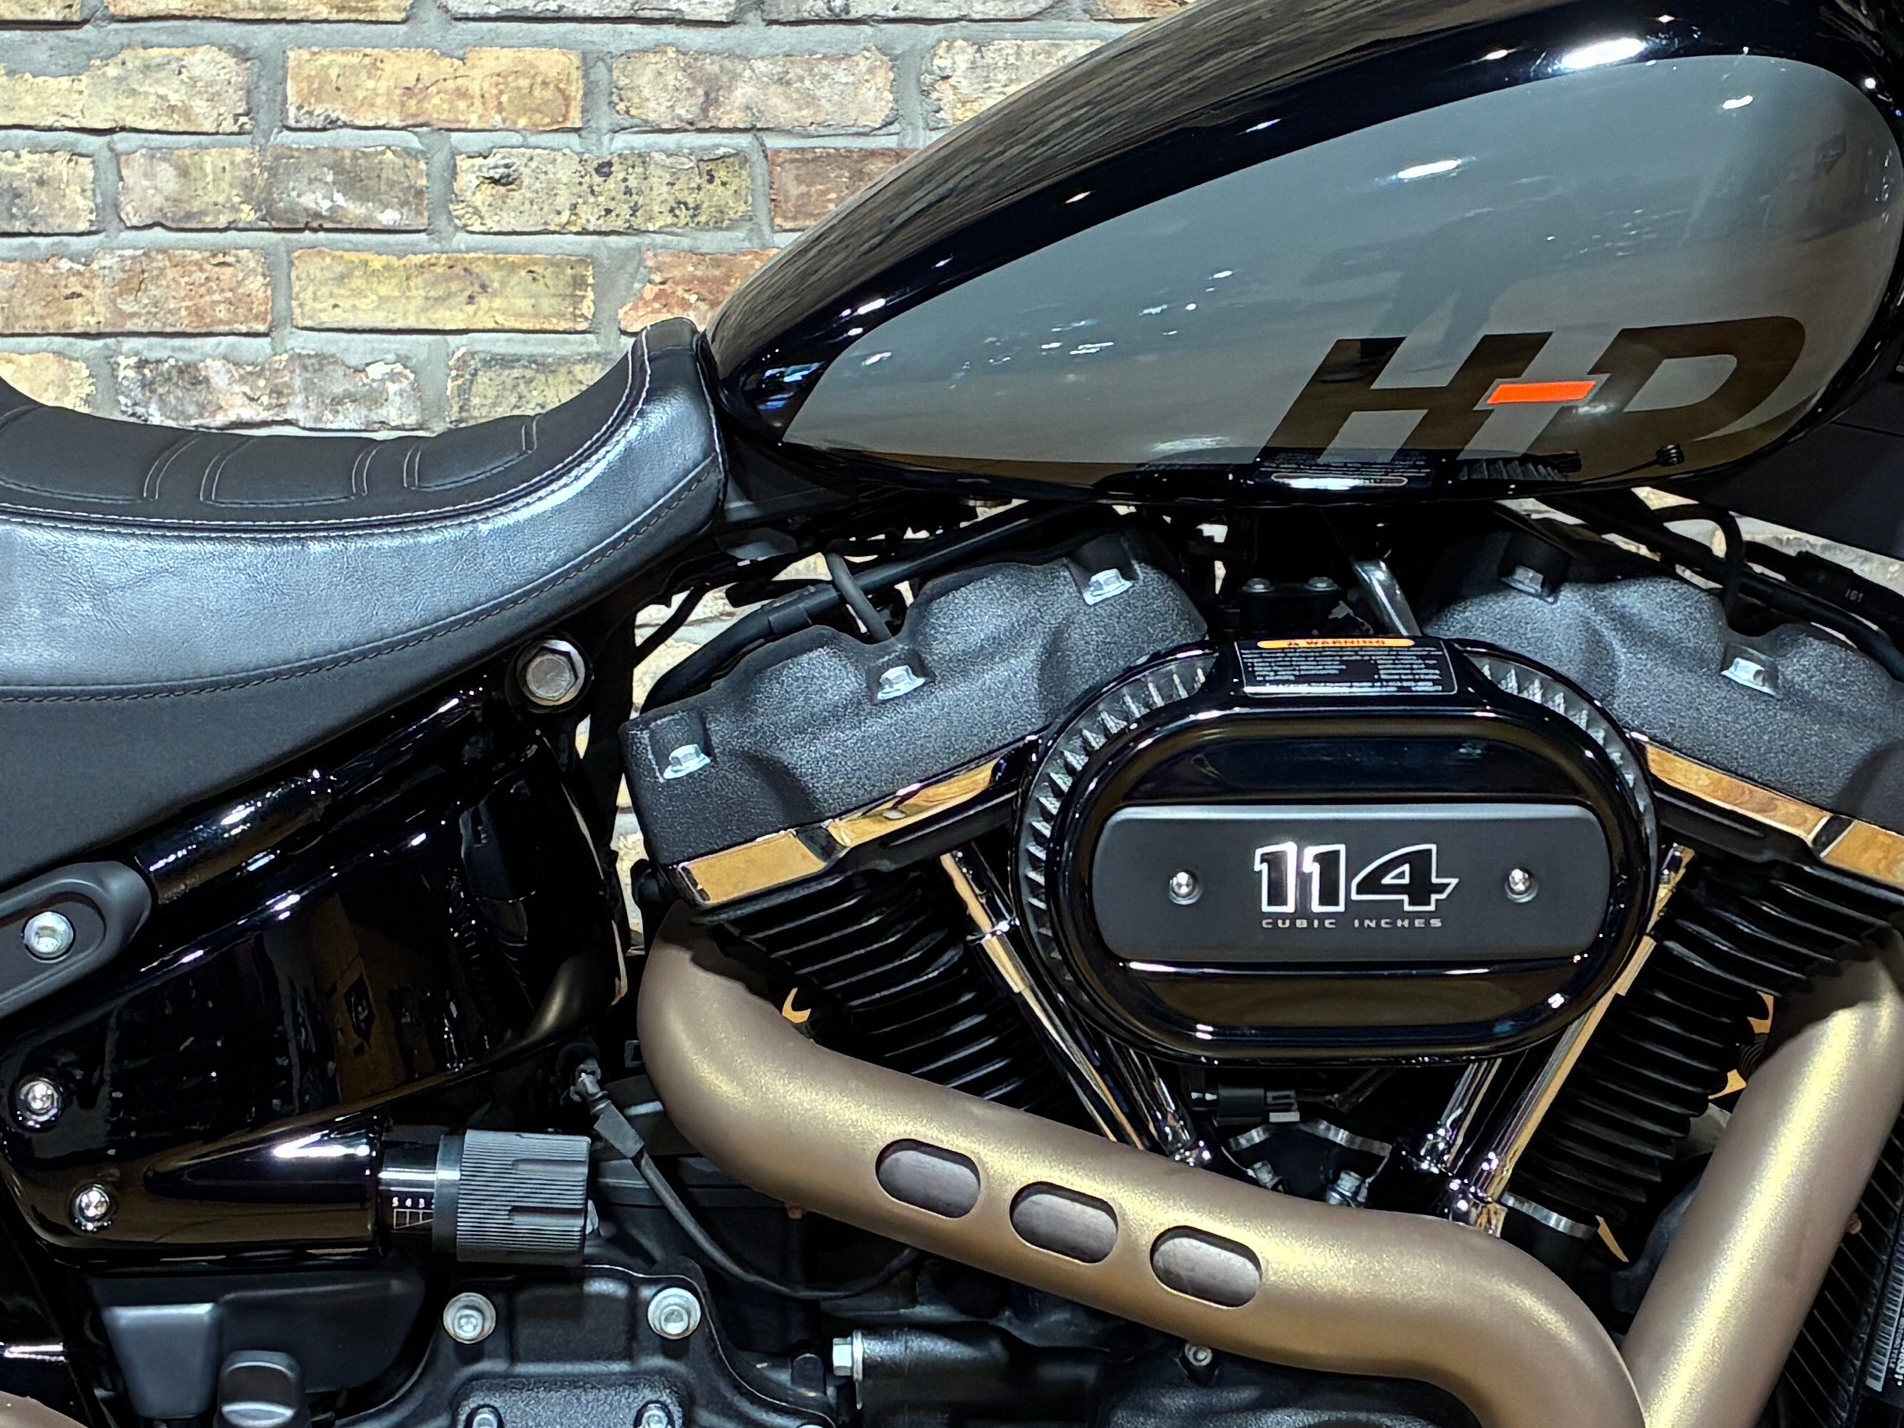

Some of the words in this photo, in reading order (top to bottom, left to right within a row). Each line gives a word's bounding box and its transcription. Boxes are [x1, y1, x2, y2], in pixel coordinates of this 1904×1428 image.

[1255, 316, 1805, 474] H-D
[1254, 842, 1459, 912] 114
[1262, 918, 1336, 928] CUBIC
[1354, 918, 1443, 928] INCHES
